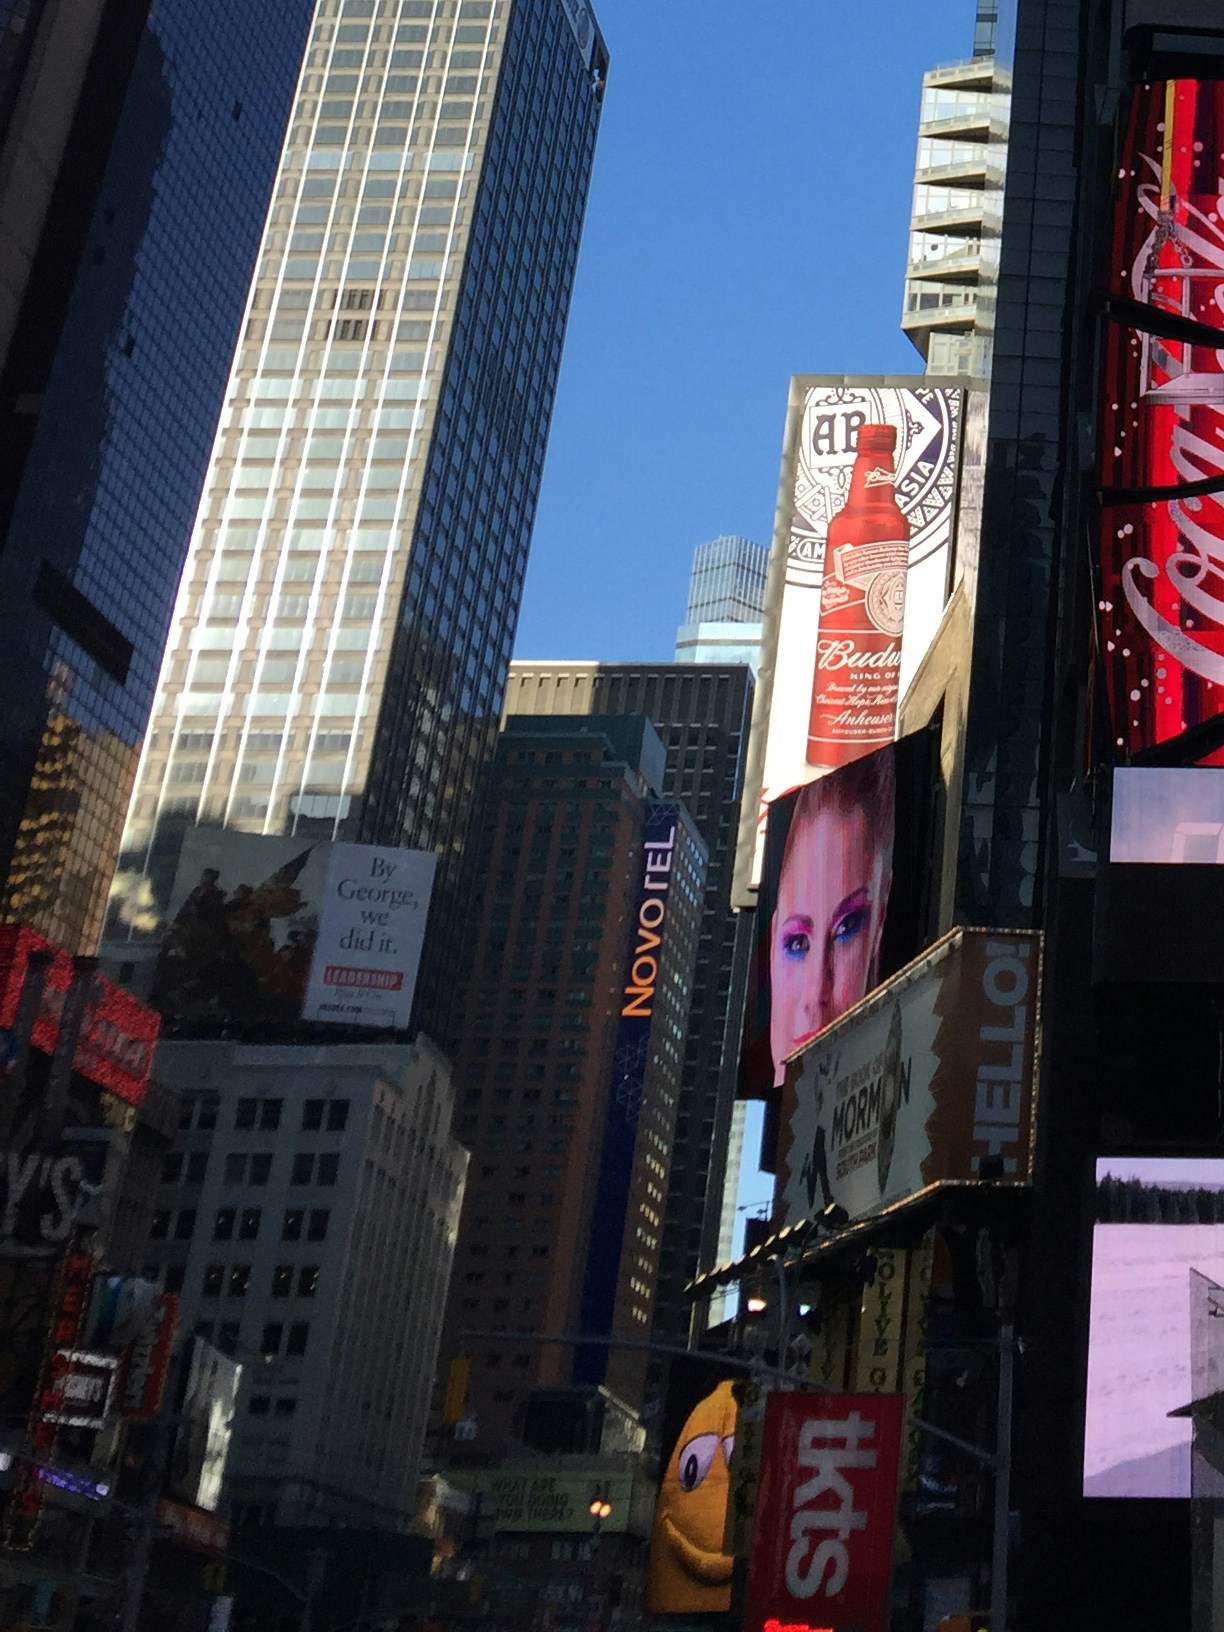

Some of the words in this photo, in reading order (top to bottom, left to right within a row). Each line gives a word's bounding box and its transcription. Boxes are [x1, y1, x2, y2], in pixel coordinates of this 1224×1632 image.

[895, 459, 935, 509] ASIA
[849, 672, 881, 680] KING
[370, 857, 398, 883] By
[336, 878, 420, 910] George,
[360, 909, 389, 926] we
[339, 927, 374, 952] did
[324, 966, 400, 988] LEADERSHIP
[785, 1410, 878, 1600] tkts
